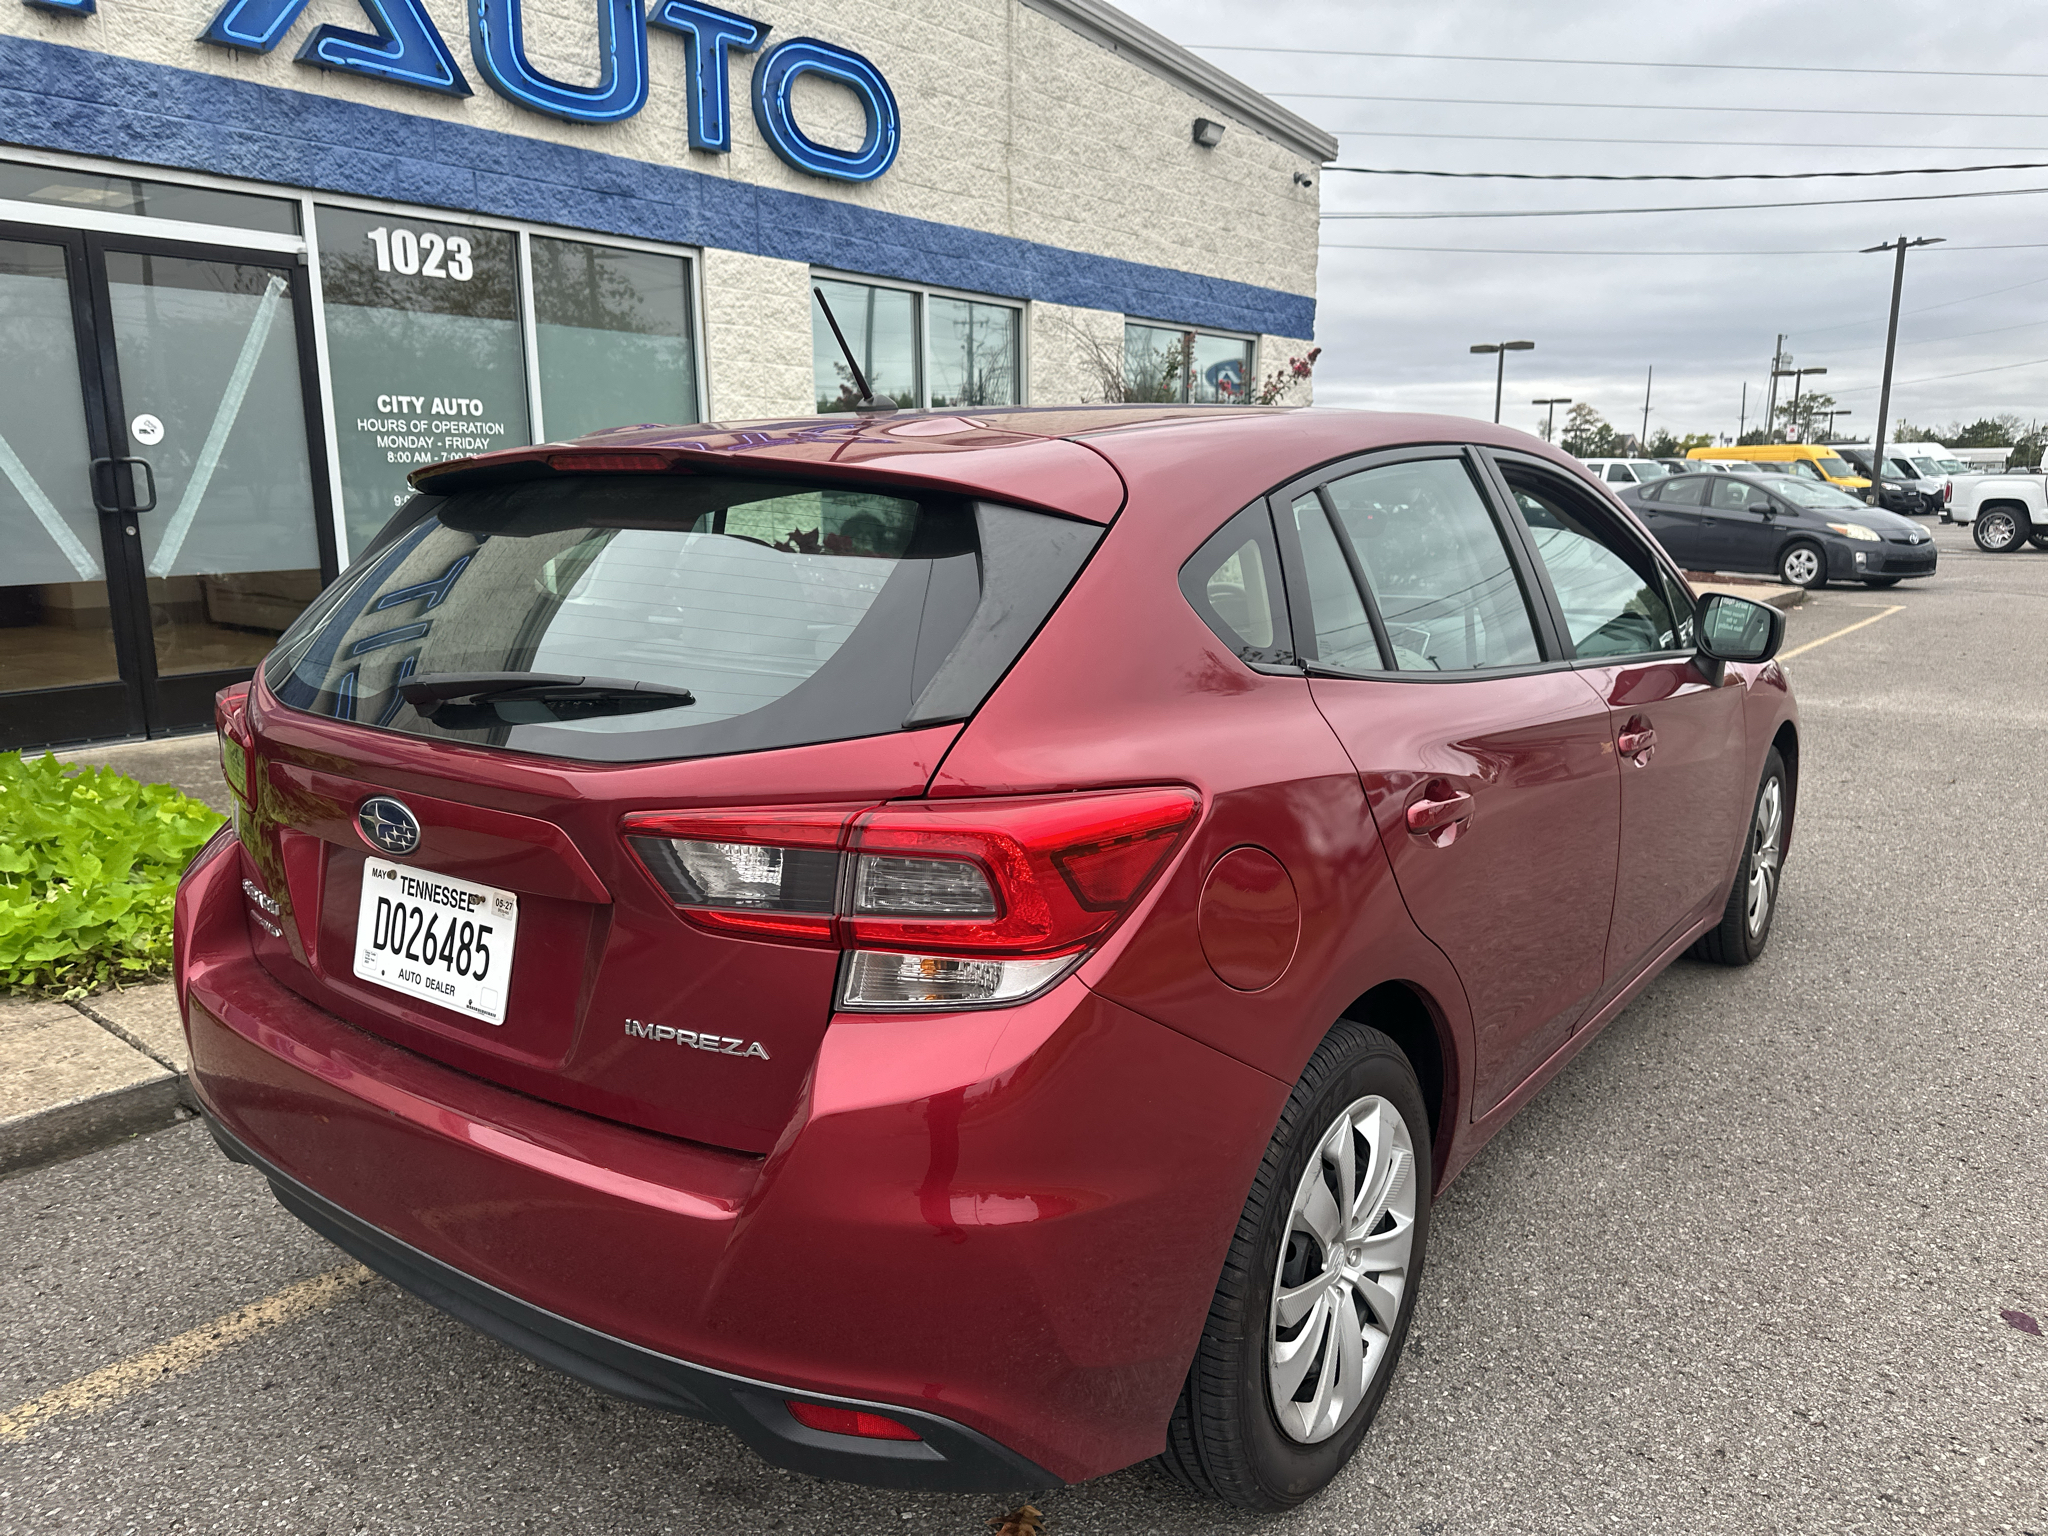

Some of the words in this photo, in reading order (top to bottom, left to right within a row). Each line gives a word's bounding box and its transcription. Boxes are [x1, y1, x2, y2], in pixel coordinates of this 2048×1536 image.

[367, 226, 474, 282] 1023
[377, 394, 425, 414] CITY
[431, 396, 484, 416] AUTO
[357, 418, 407, 433] HOURS
[410, 419, 428, 433] OF
[432, 420, 505, 435] OPERATION
[377, 436, 434, 450] MONDAY
[445, 437, 490, 450] FRIDAY
[387, 451, 411, 463] 8:00
[413, 451, 432, 463] AM
[371, 867, 387, 880] MAY
[400, 875, 476, 913] TENNESSEE
[495, 897, 513, 911] 05-27
[372, 896, 493, 982] D026485
[398, 968, 422, 985] AUTO
[425, 977, 456, 996] DEALER
[625, 1018, 771, 1060] IMPREZA
